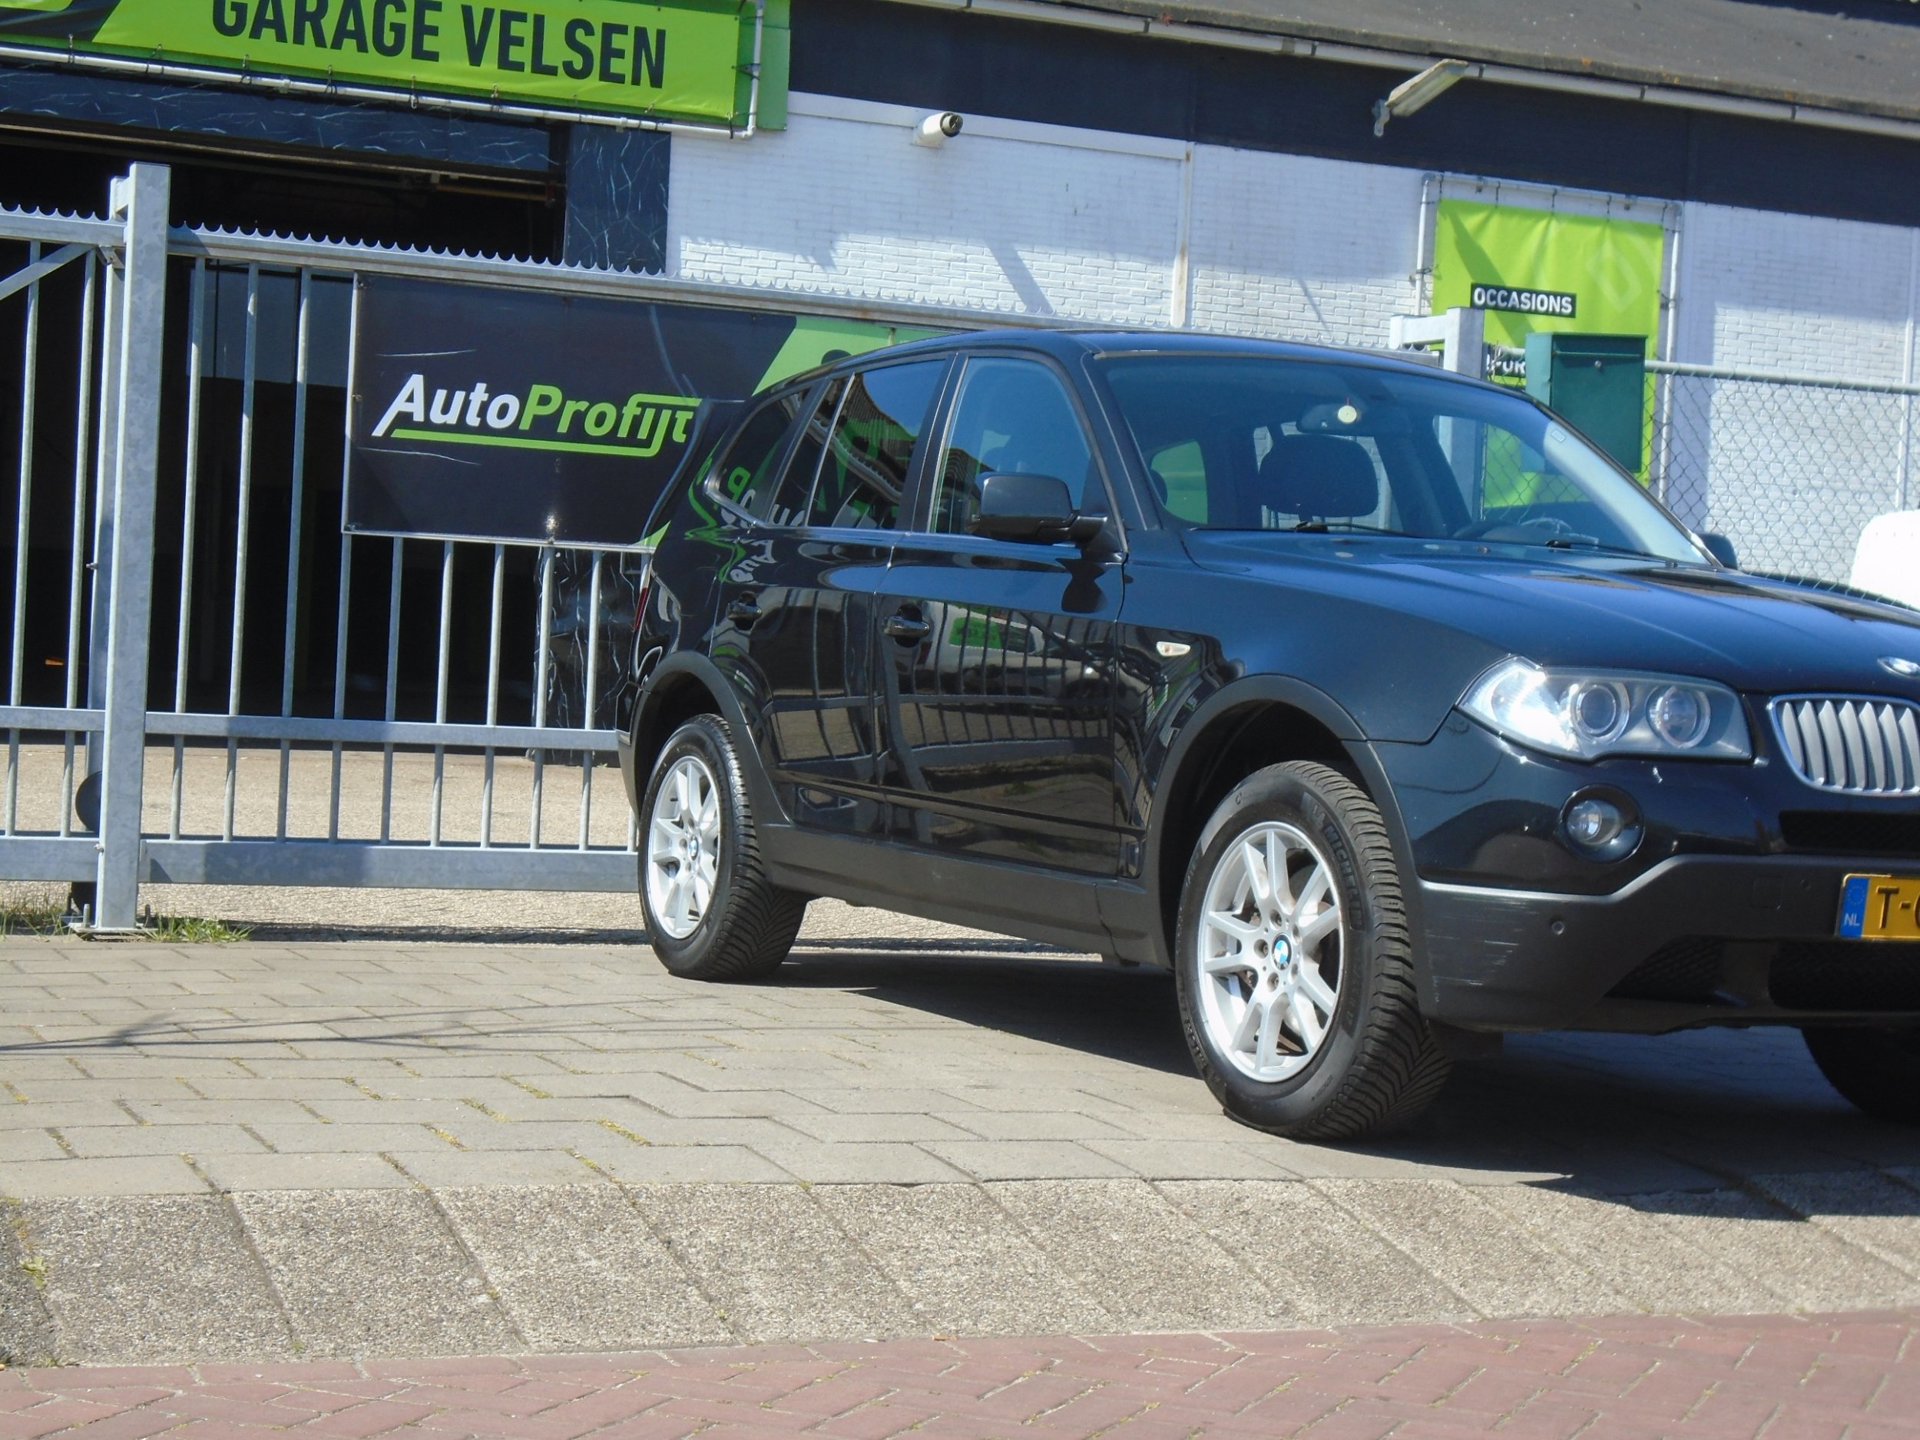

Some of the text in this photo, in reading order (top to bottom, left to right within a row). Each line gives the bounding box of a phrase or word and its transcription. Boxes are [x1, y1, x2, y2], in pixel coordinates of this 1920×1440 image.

[213, 0, 666, 89] GARAGE VELSEN
[1473, 287, 1573, 315] OCCASIONS
[371, 374, 702, 457] AutoProfijt
[1843, 912, 1861, 927] NL
